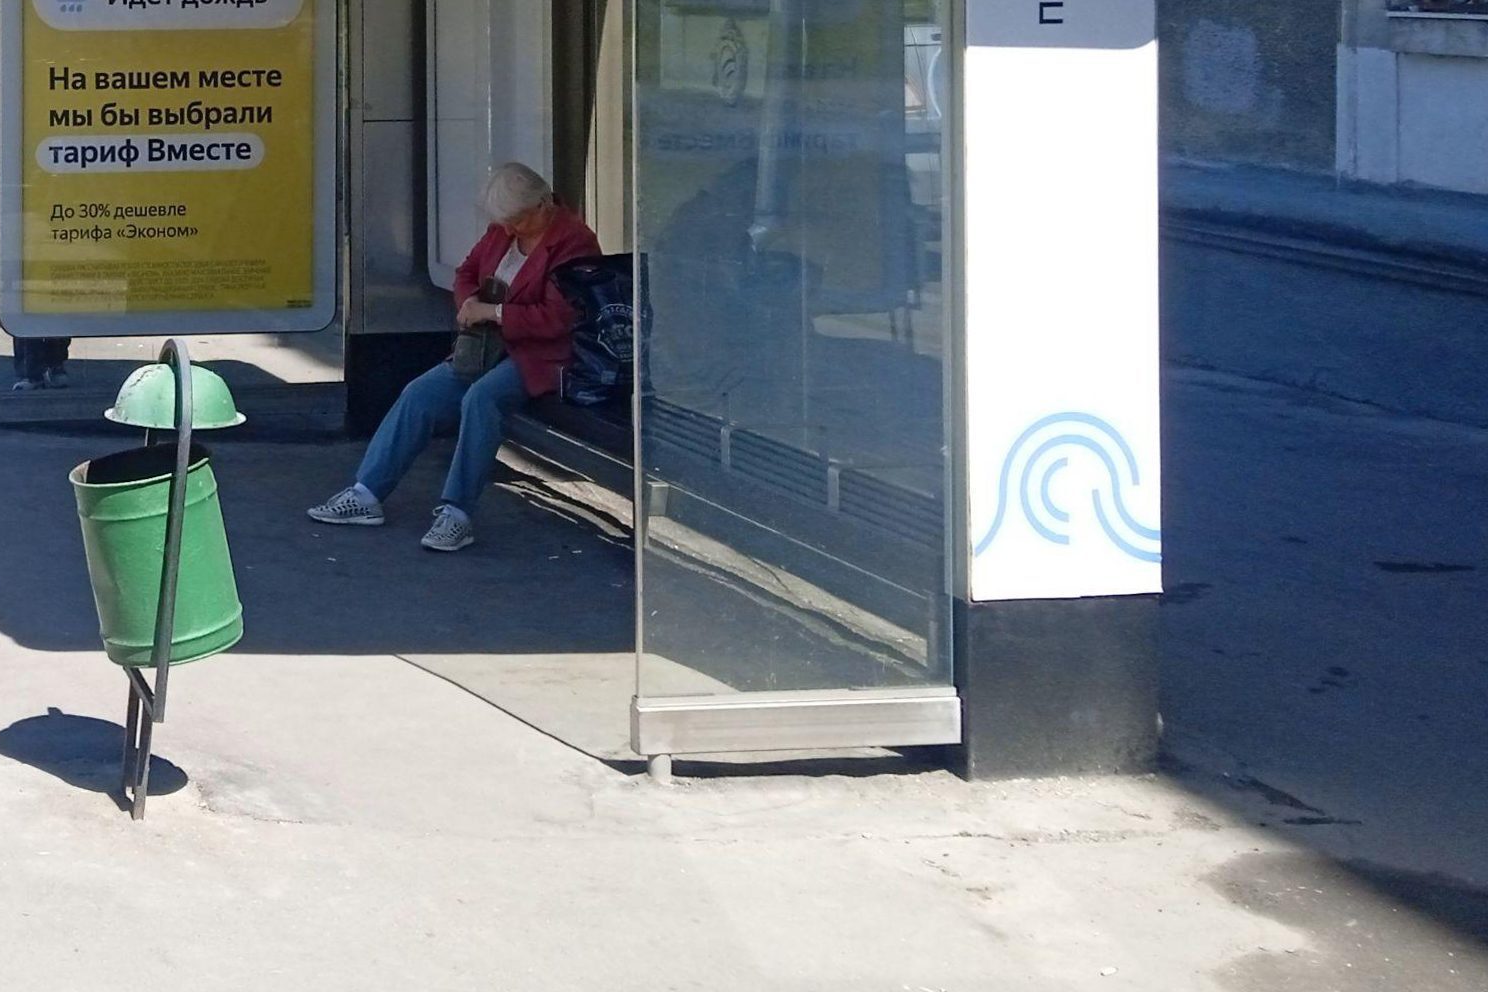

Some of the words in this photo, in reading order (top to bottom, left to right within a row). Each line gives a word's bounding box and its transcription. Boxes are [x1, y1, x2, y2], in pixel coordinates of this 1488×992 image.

[49, 67, 86, 90] На
[95, 67, 190, 90] вашем
[198, 67, 282, 88] месте
[49, 107, 92, 127] мы
[101, 101, 140, 126] бы
[148, 103, 273, 129] выбрали
[49, 139, 139, 168] тариф
[148, 139, 251, 163] Вместе
[51, 203, 74, 221] До
[79, 203, 110, 218] 30%
[114, 204, 186, 221] дешевле
[51, 225, 112, 242] тарифа
[116, 223, 198, 241] «Эконом»
